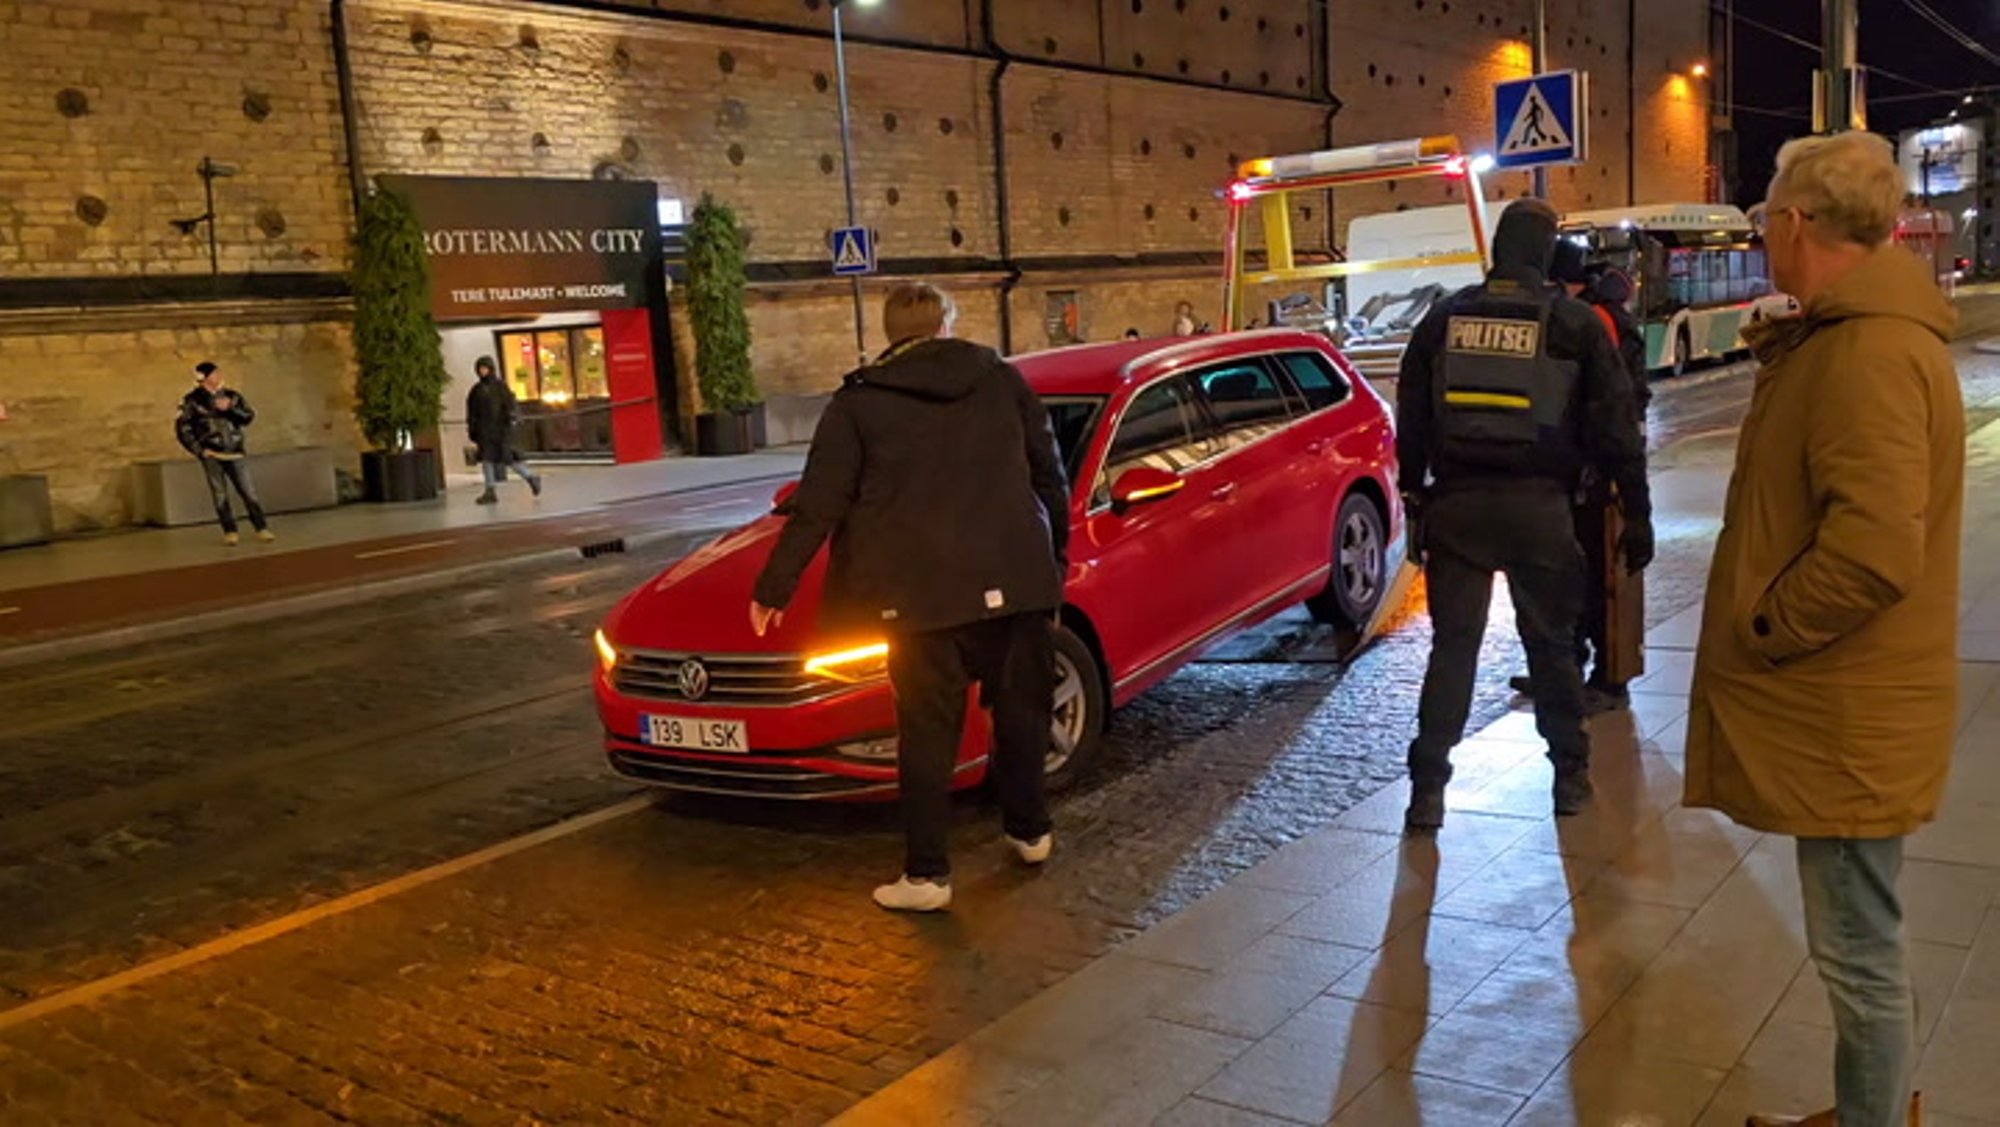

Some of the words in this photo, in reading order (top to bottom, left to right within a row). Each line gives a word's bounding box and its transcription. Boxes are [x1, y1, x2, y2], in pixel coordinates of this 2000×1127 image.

[591, 229, 644, 253] CITY
[452, 289, 485, 302] TERE
[489, 286, 555, 301] TULEMAST
[565, 283, 626, 298] WELCOME
[1451, 320, 1535, 353] POLITSEI
[653, 718, 683, 744] 139
[699, 722, 739, 748] LSK
